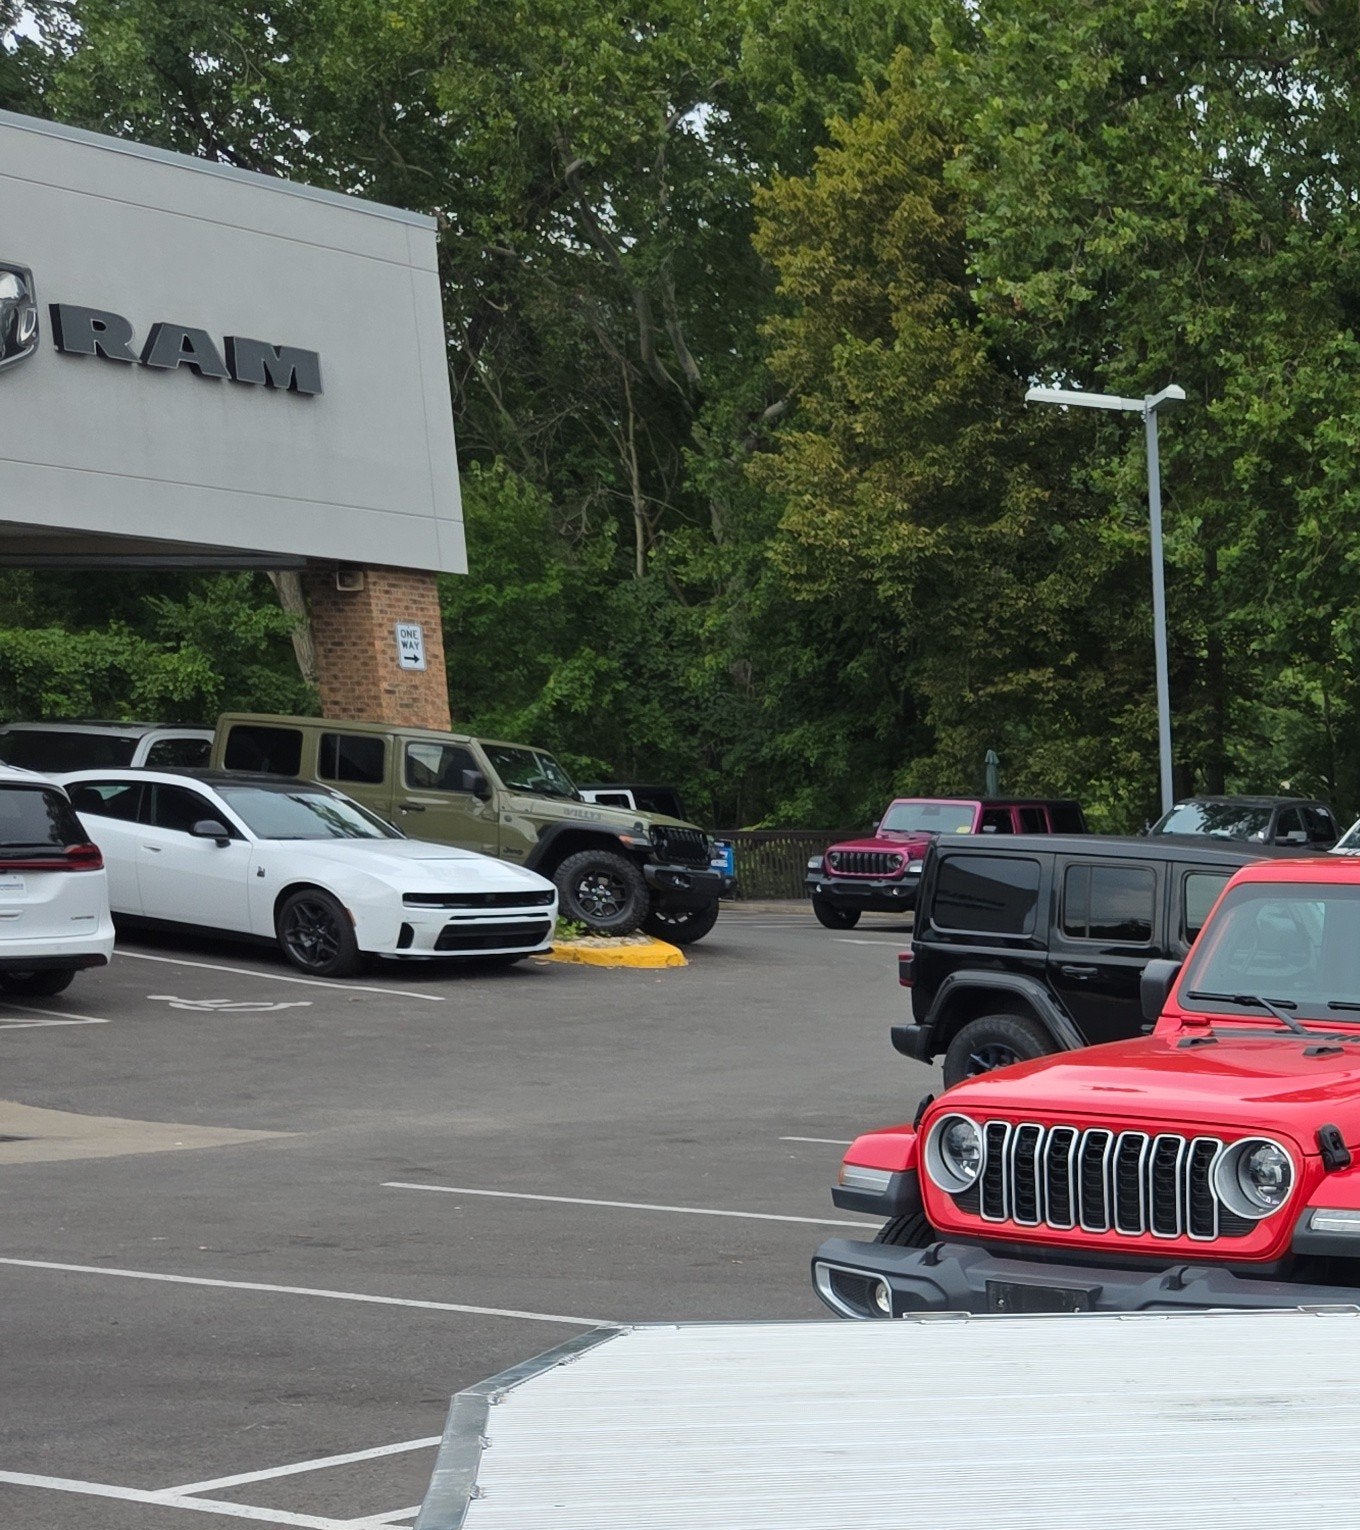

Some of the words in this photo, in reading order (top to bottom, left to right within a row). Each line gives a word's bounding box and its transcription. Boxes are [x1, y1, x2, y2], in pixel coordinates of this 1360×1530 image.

[49, 302, 324, 396] RAM
[400, 629, 418, 639] ONE
[401, 640, 420, 650] WAY
